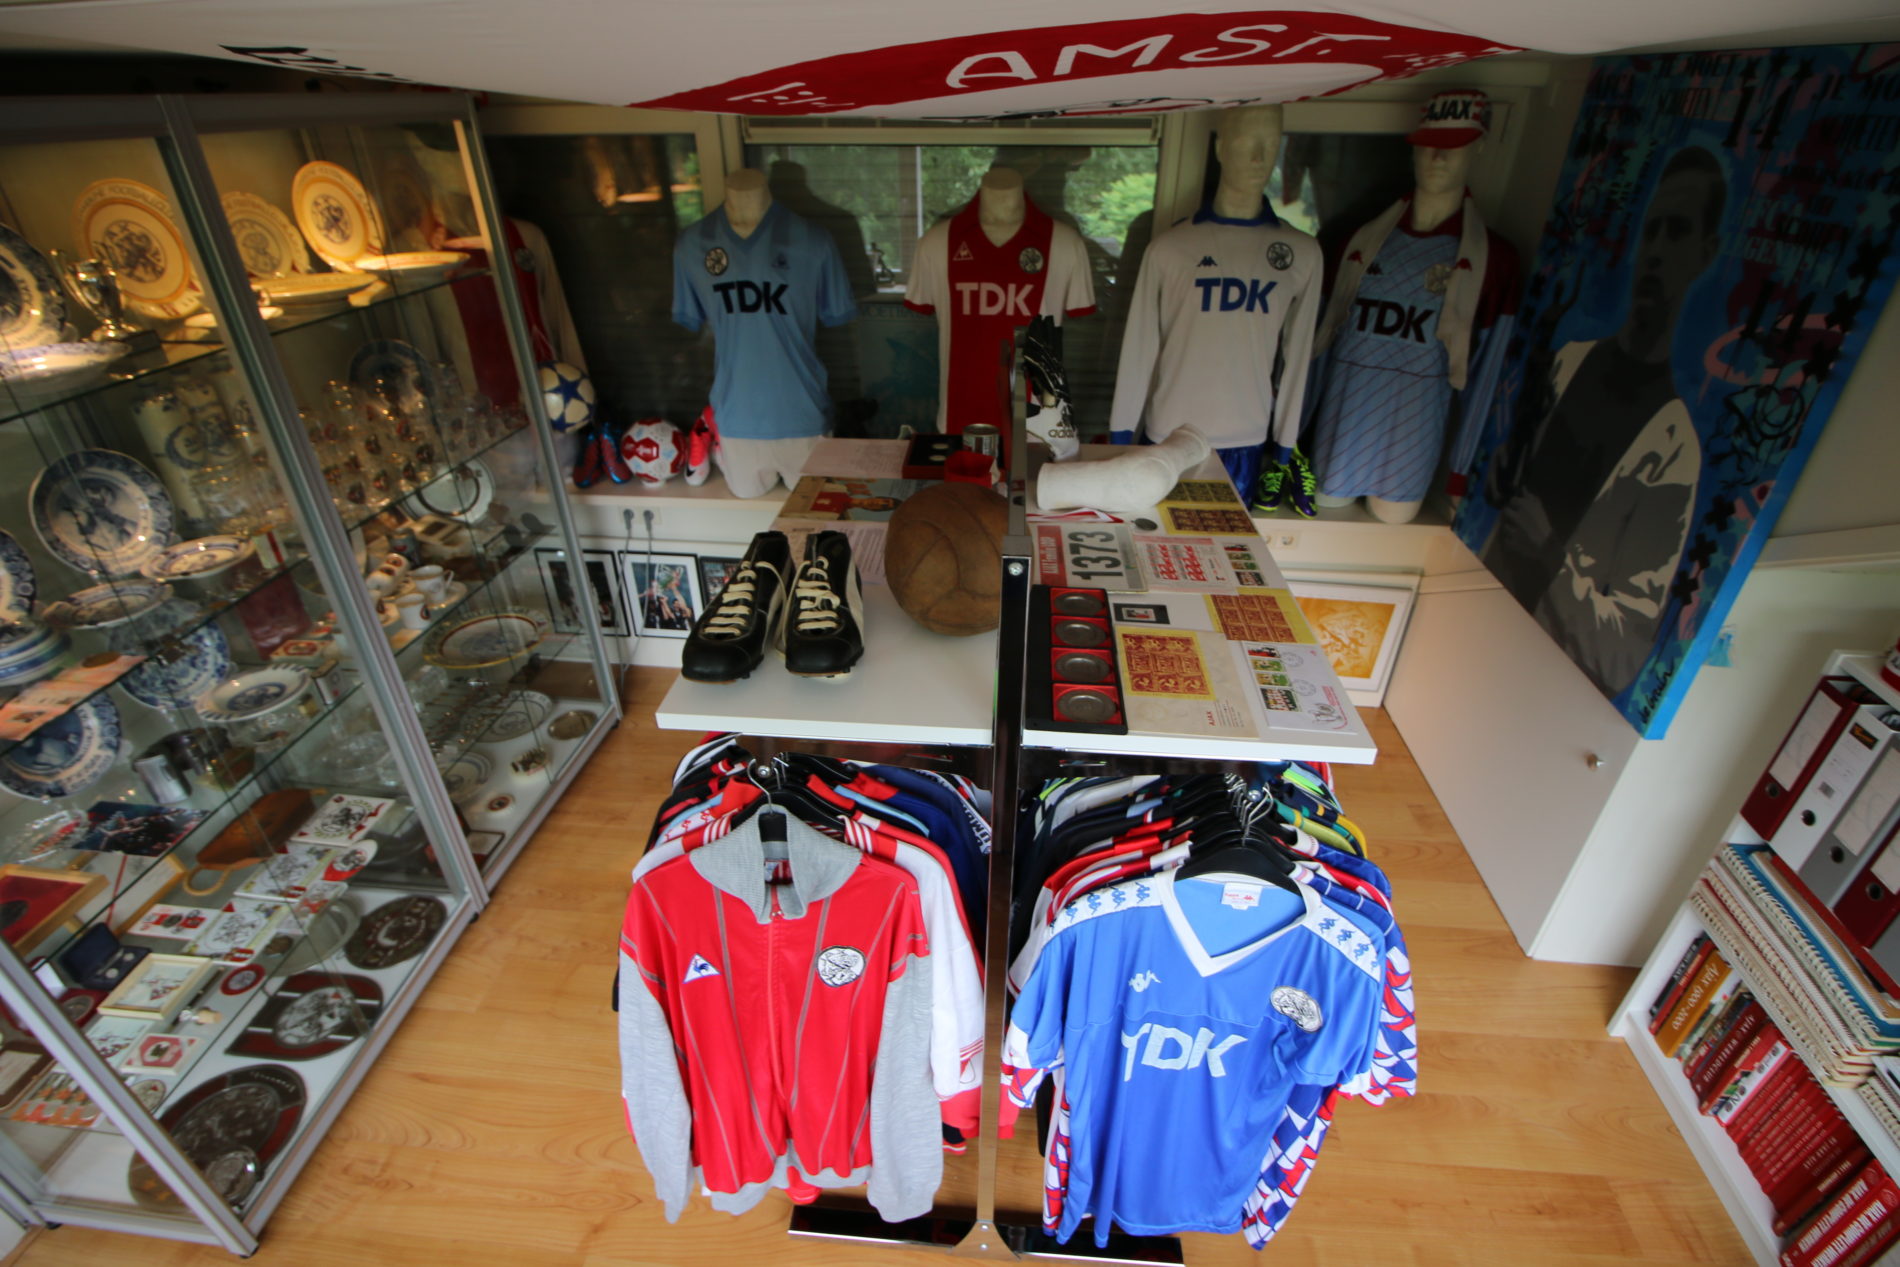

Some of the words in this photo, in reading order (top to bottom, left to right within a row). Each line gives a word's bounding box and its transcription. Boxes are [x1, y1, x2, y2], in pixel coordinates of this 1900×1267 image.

[1425, 99, 1472, 120] AJAX
[713, 280, 788, 315] TDK
[956, 282, 1034, 316] TDK
[1194, 277, 1277, 314] TDK
[1354, 297, 1435, 343] TDK
[1068, 531, 1123, 581] 1373
[1702, 962, 1719, 986] Ajax
[1121, 1022, 1248, 1082] TDK
